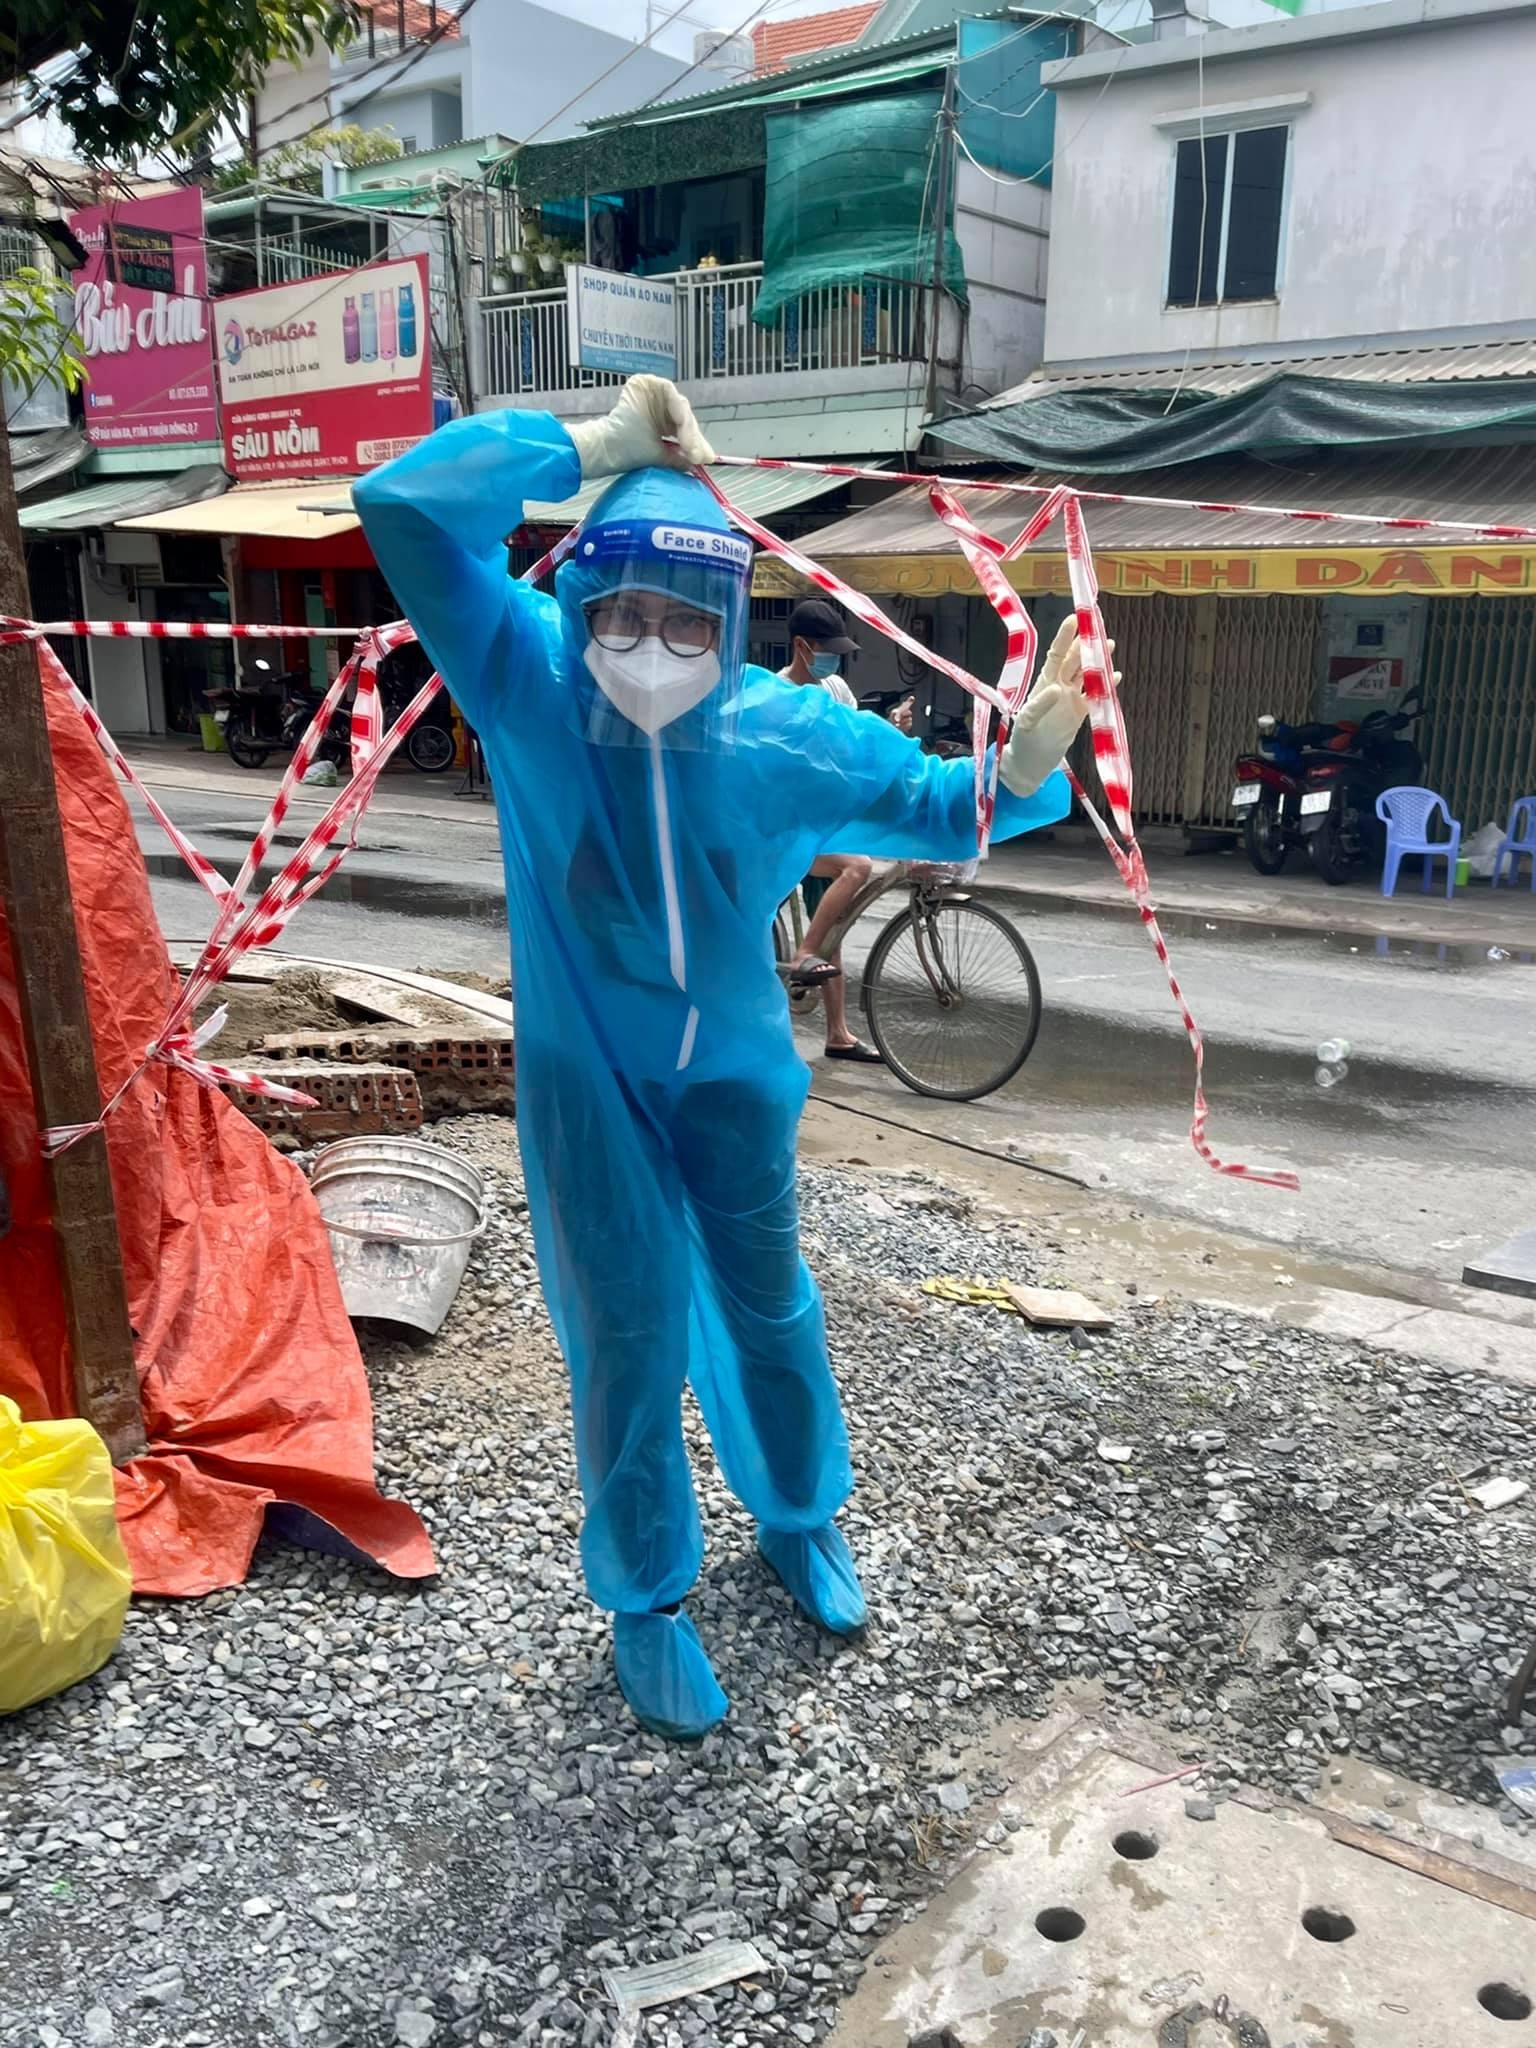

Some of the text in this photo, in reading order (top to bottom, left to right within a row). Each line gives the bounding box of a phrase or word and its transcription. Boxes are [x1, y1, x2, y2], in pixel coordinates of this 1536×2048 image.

[583, 277, 608, 293] SHOP
[652, 291, 673, 305] NAM
[634, 337, 658, 352] TRANG
[231, 418, 320, 461] SÁU NỒM
[663, 531, 748, 561] Face Shield
[1296, 549, 1529, 589] DÂN
